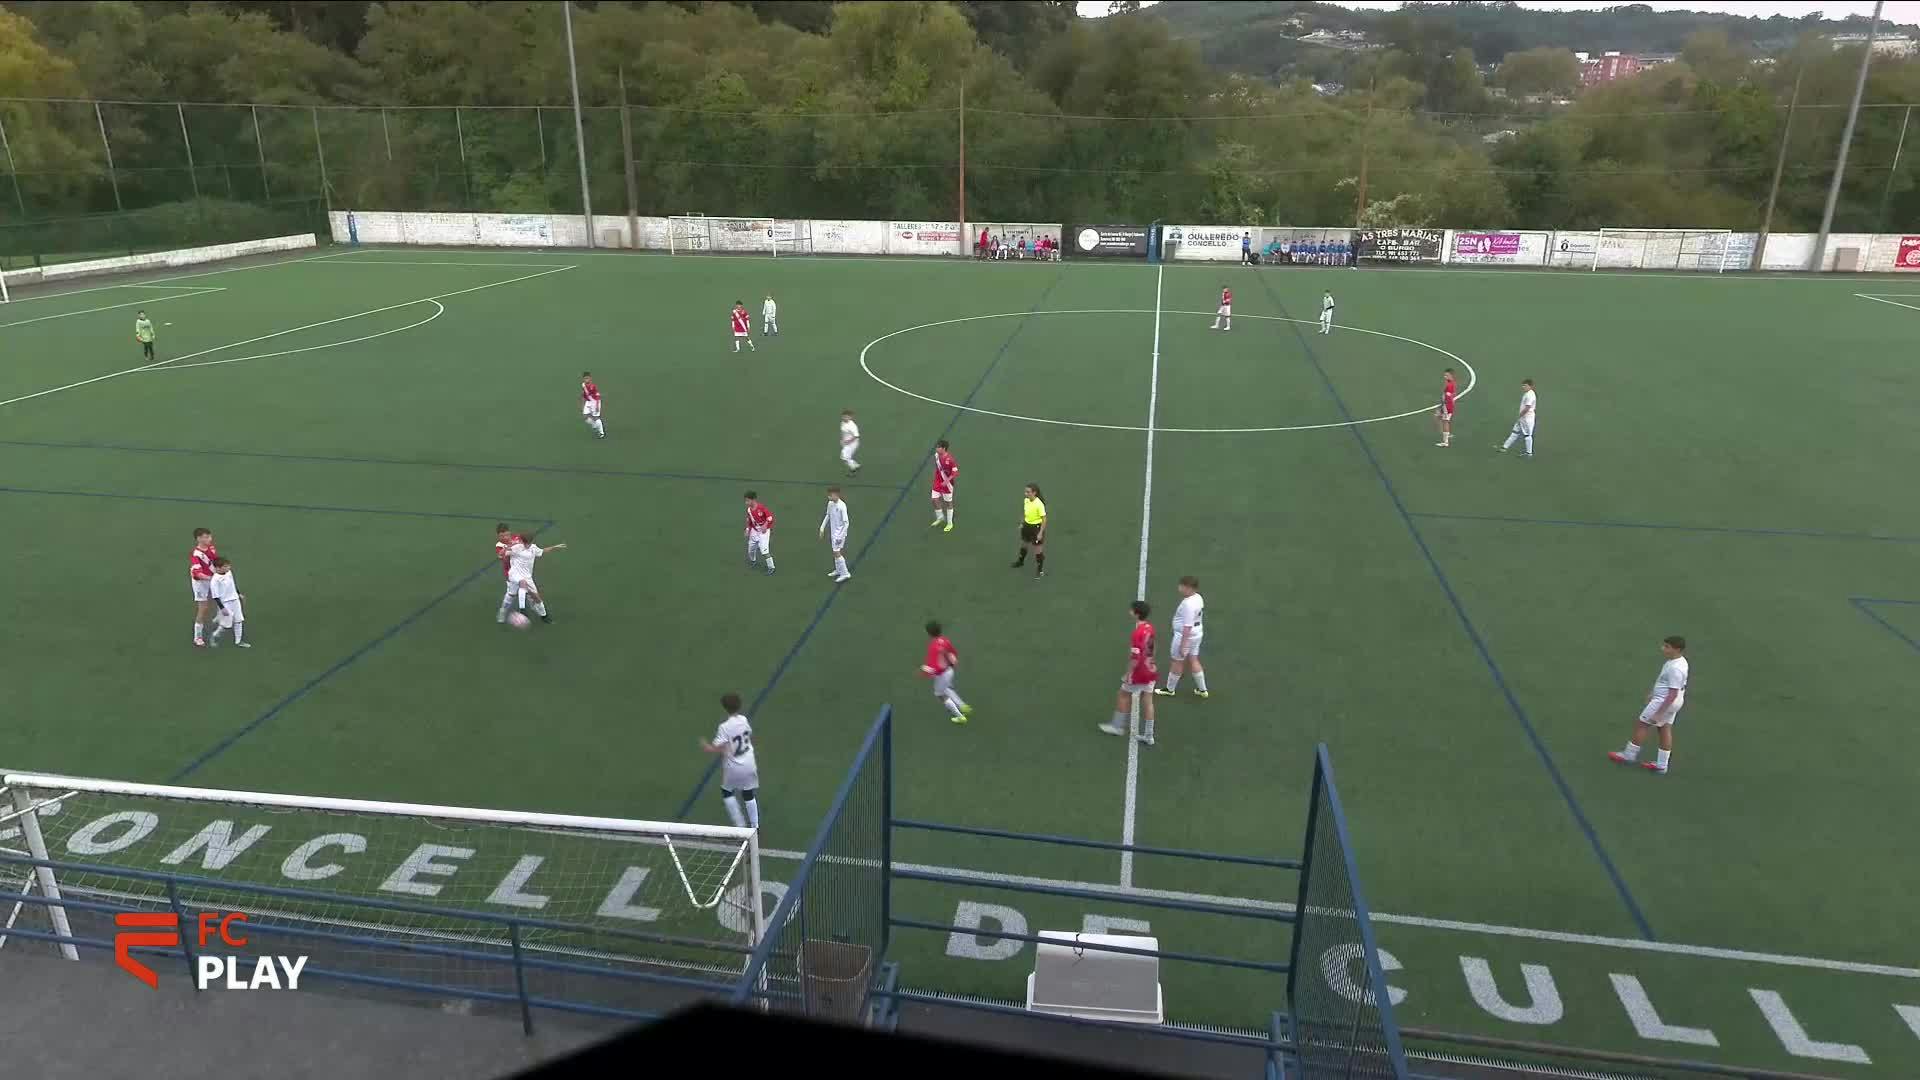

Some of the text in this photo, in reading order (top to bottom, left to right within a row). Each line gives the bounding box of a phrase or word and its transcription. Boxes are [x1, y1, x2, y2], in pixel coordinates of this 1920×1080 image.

[1375, 229, 1398, 239] TRES
[1401, 229, 1439, 242] MARIAS
[1459, 237, 1477, 245] 25N
[1319, 943, 1920, 1064] CULL
